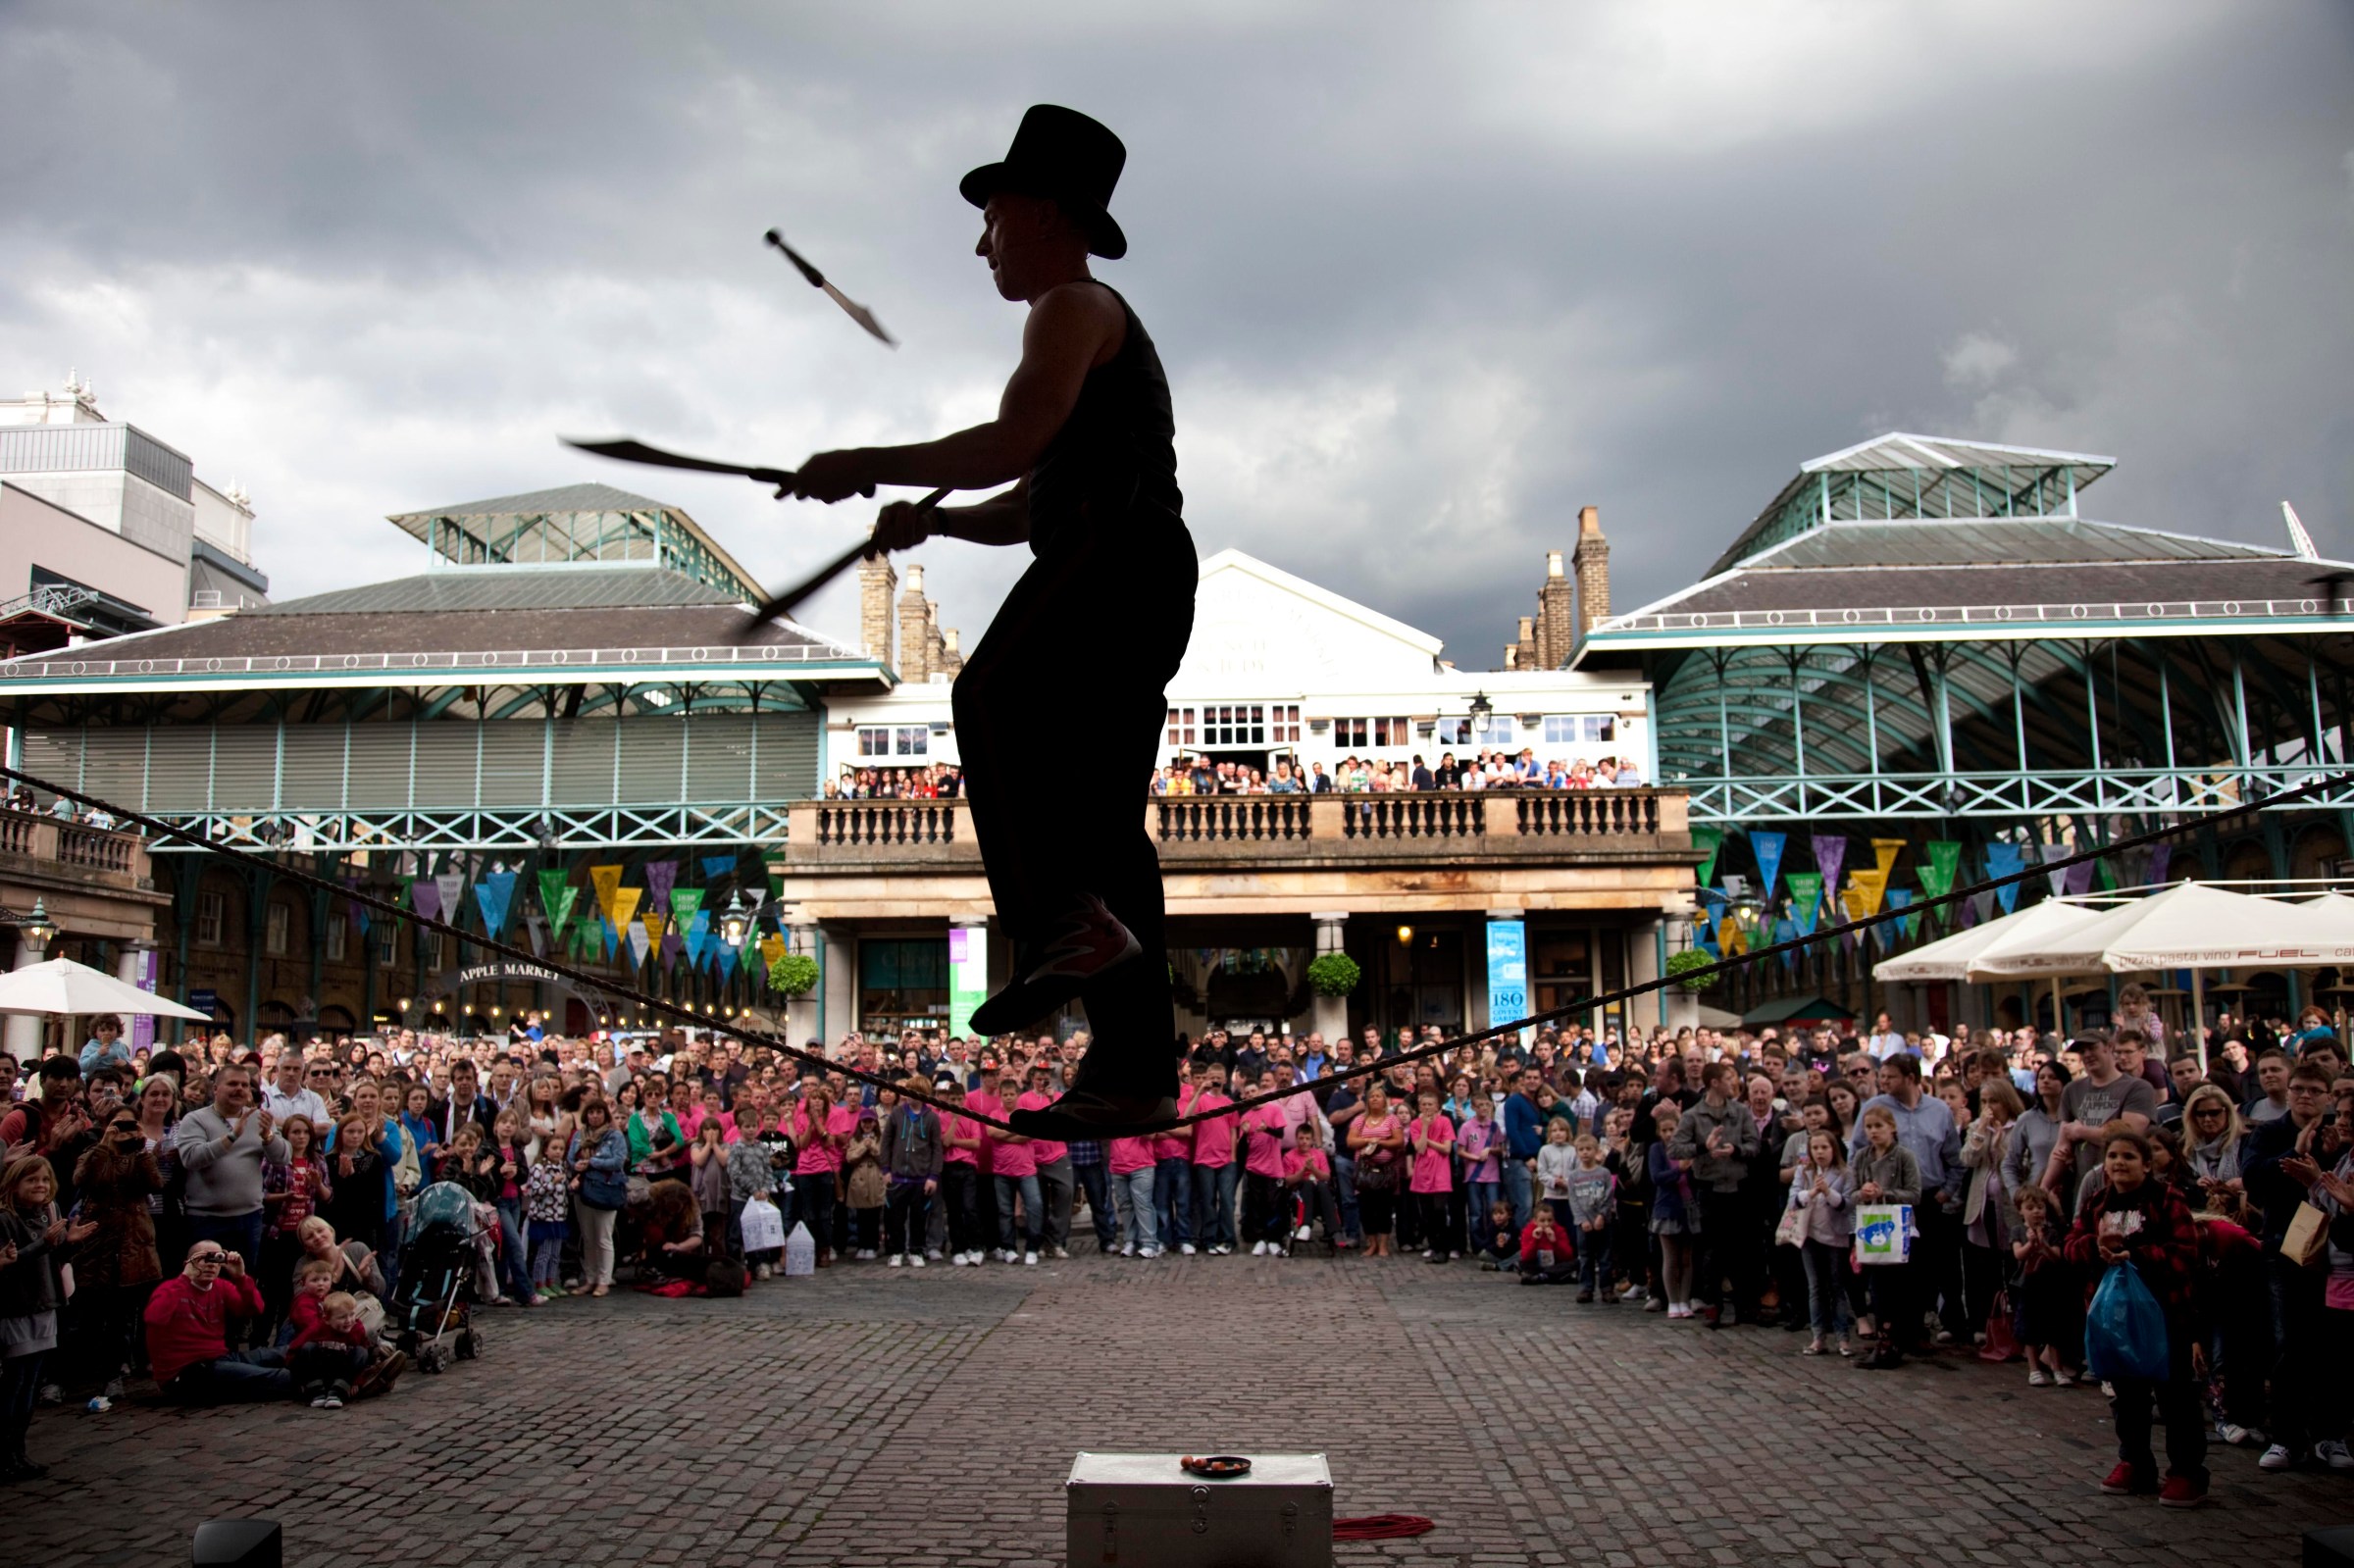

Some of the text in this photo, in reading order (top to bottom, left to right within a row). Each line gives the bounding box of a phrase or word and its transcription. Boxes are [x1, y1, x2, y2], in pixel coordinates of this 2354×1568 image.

[2120, 954, 2154, 967] pizza
[2159, 951, 2198, 967] pasta
[2203, 950, 2231, 961] vino
[2237, 948, 2320, 959] FUEL
[459, 963, 560, 983] APPLE MARKET
[1493, 992, 1523, 1007] 180
